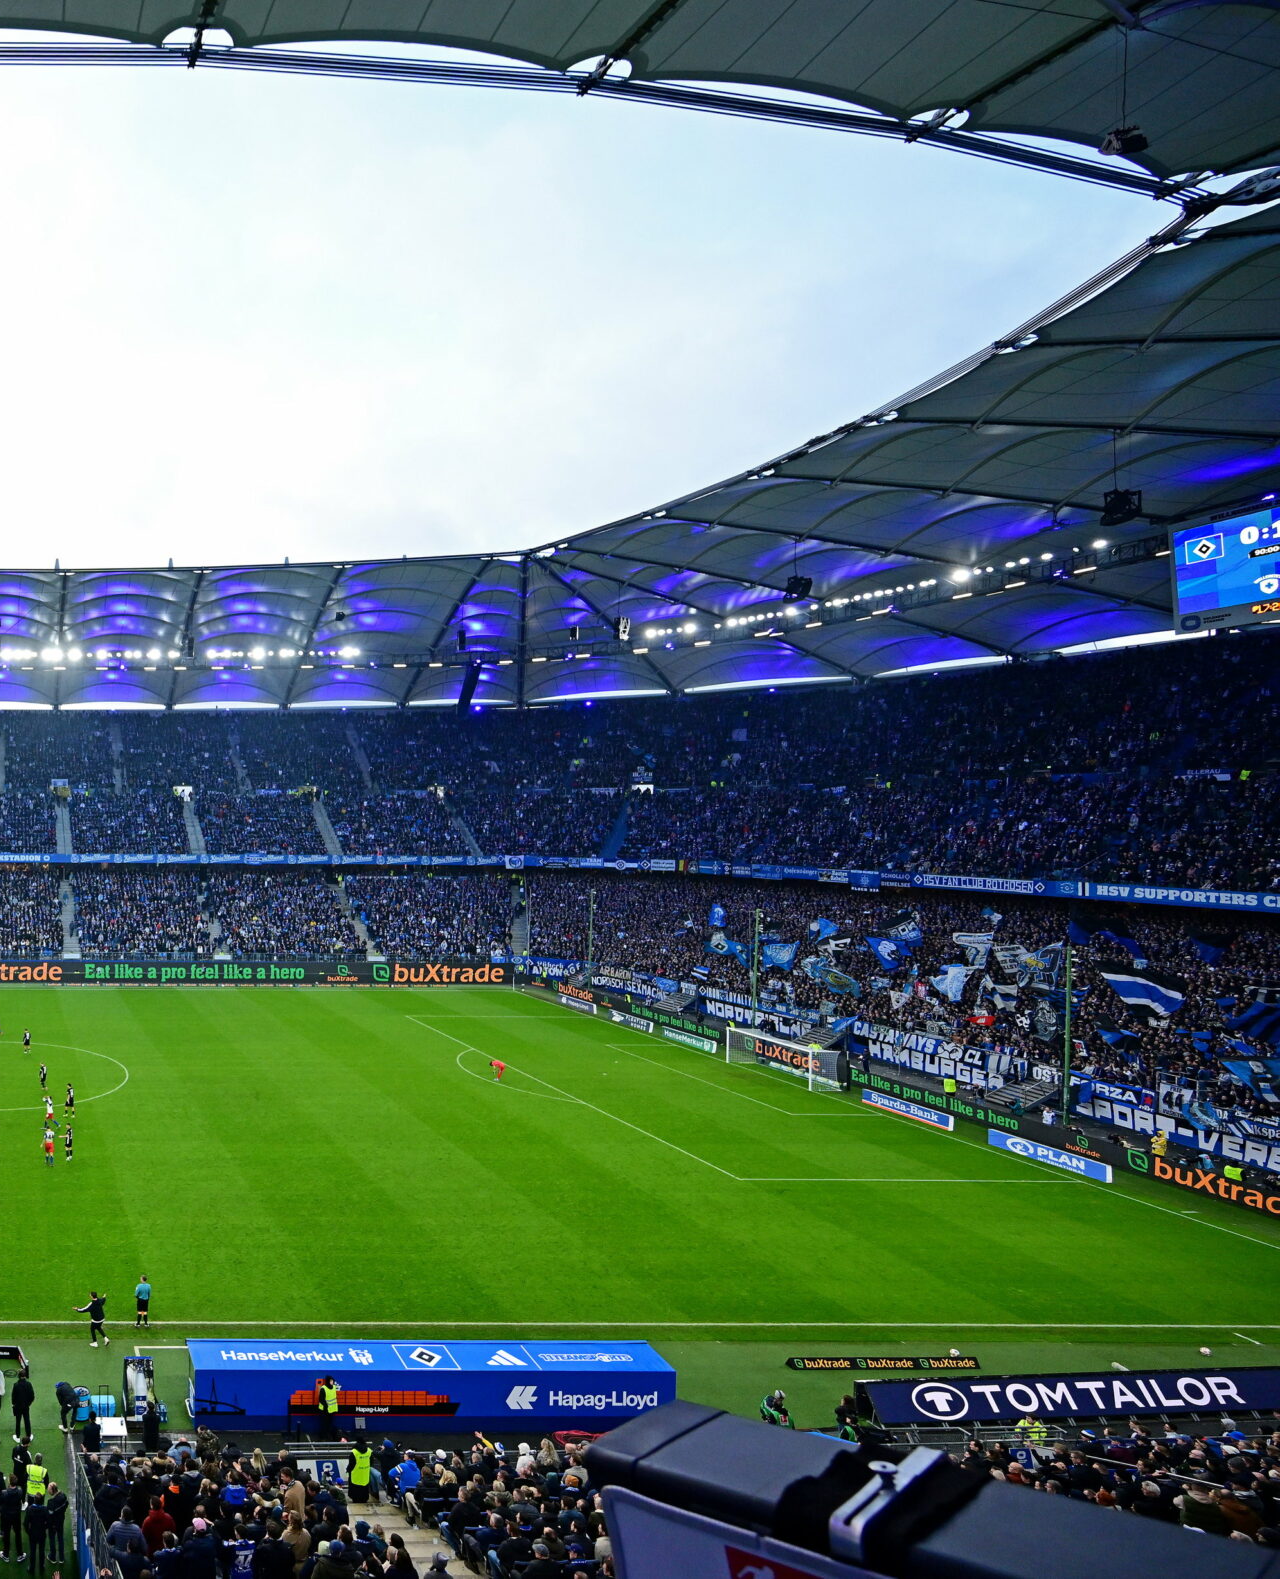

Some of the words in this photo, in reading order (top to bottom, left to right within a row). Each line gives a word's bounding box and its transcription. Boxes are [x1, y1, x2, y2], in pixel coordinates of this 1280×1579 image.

[923, 875, 940, 886] HSV
[942, 877, 959, 887] FAN
[960, 878, 984, 889] CLUB
[1096, 885, 1131, 897] HSV
[1133, 888, 1258, 907] SUPPORTERS
[84, 963, 111, 979] Eat
[114, 963, 143, 979] like
[147, 967, 157, 979] a
[161, 967, 187, 982] pro
[190, 964, 219, 979] feel
[223, 963, 252, 979] like
[256, 968, 266, 980] a
[270, 964, 305, 980] hero
[394, 963, 504, 983] buXtrade
[558, 982, 594, 1001] buXtrade
[664, 1028, 704, 1049] HanseMerkur
[704, 1026, 720, 1039] hero
[755, 1038, 821, 1072] buXtrade
[851, 1069, 868, 1085] Eat
[871, 1074, 891, 1091] like
[893, 1083, 901, 1094] a
[903, 1085, 922, 1101] pro
[924, 1091, 948, 1109] feel
[950, 1097, 974, 1117] like
[976, 1109, 985, 1120] a
[988, 1109, 1019, 1131] hero
[871, 1092, 939, 1122] Sparda-Bank
[1037, 1146, 1086, 1171] PLAN
[1065, 1143, 1101, 1159] buXtrade
[220, 1350, 344, 1362] HanseMerkur
[805, 1358, 851, 1369] buXtrade
[867, 1358, 914, 1369] buXtrade
[930, 1358, 976, 1369] buXtrade
[549, 1390, 658, 1410] Hapag-Lloyd
[969, 1381, 1078, 1415] TOM
[1074, 1376, 1247, 1411] TAILOR
